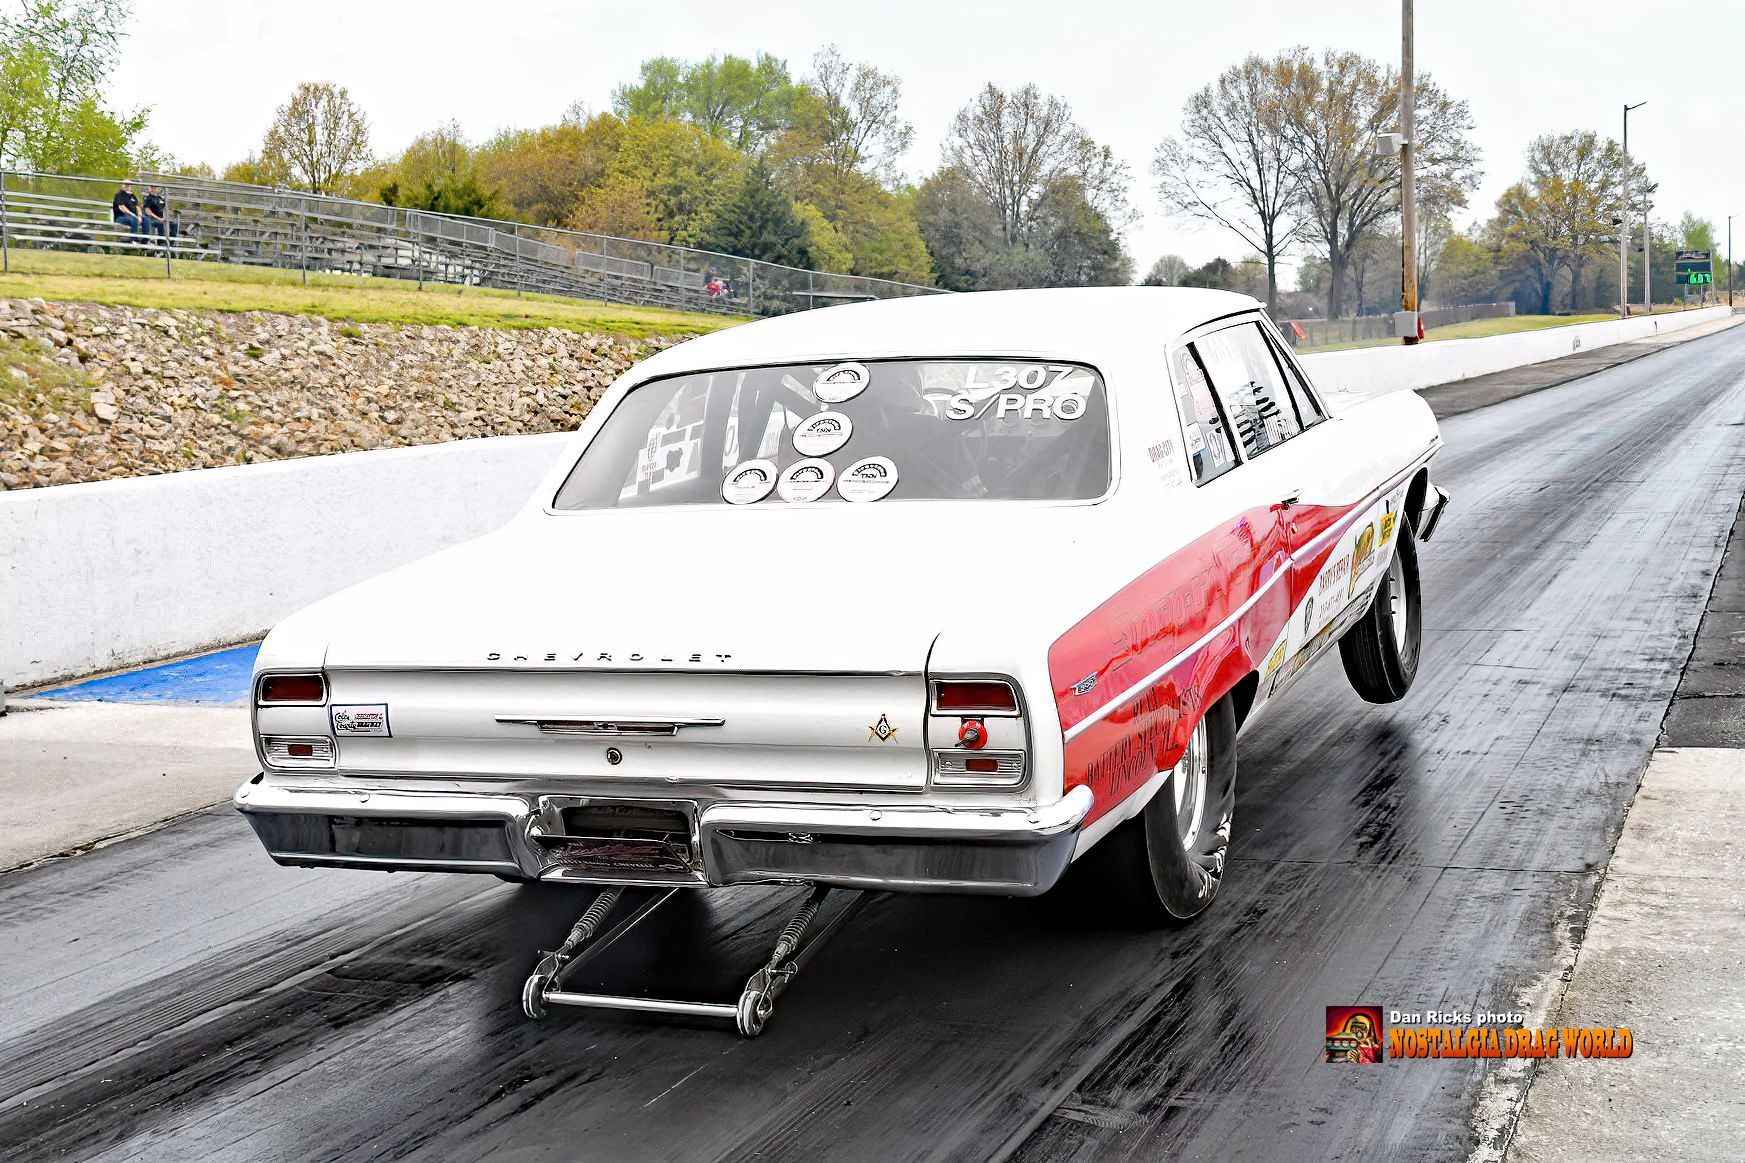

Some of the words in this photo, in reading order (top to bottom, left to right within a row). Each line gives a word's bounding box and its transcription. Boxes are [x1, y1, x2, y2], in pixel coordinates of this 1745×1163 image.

[966, 365, 1074, 391] L307
[945, 394, 1088, 421] S/PRO
[487, 652, 732, 664] CHEVROLET
